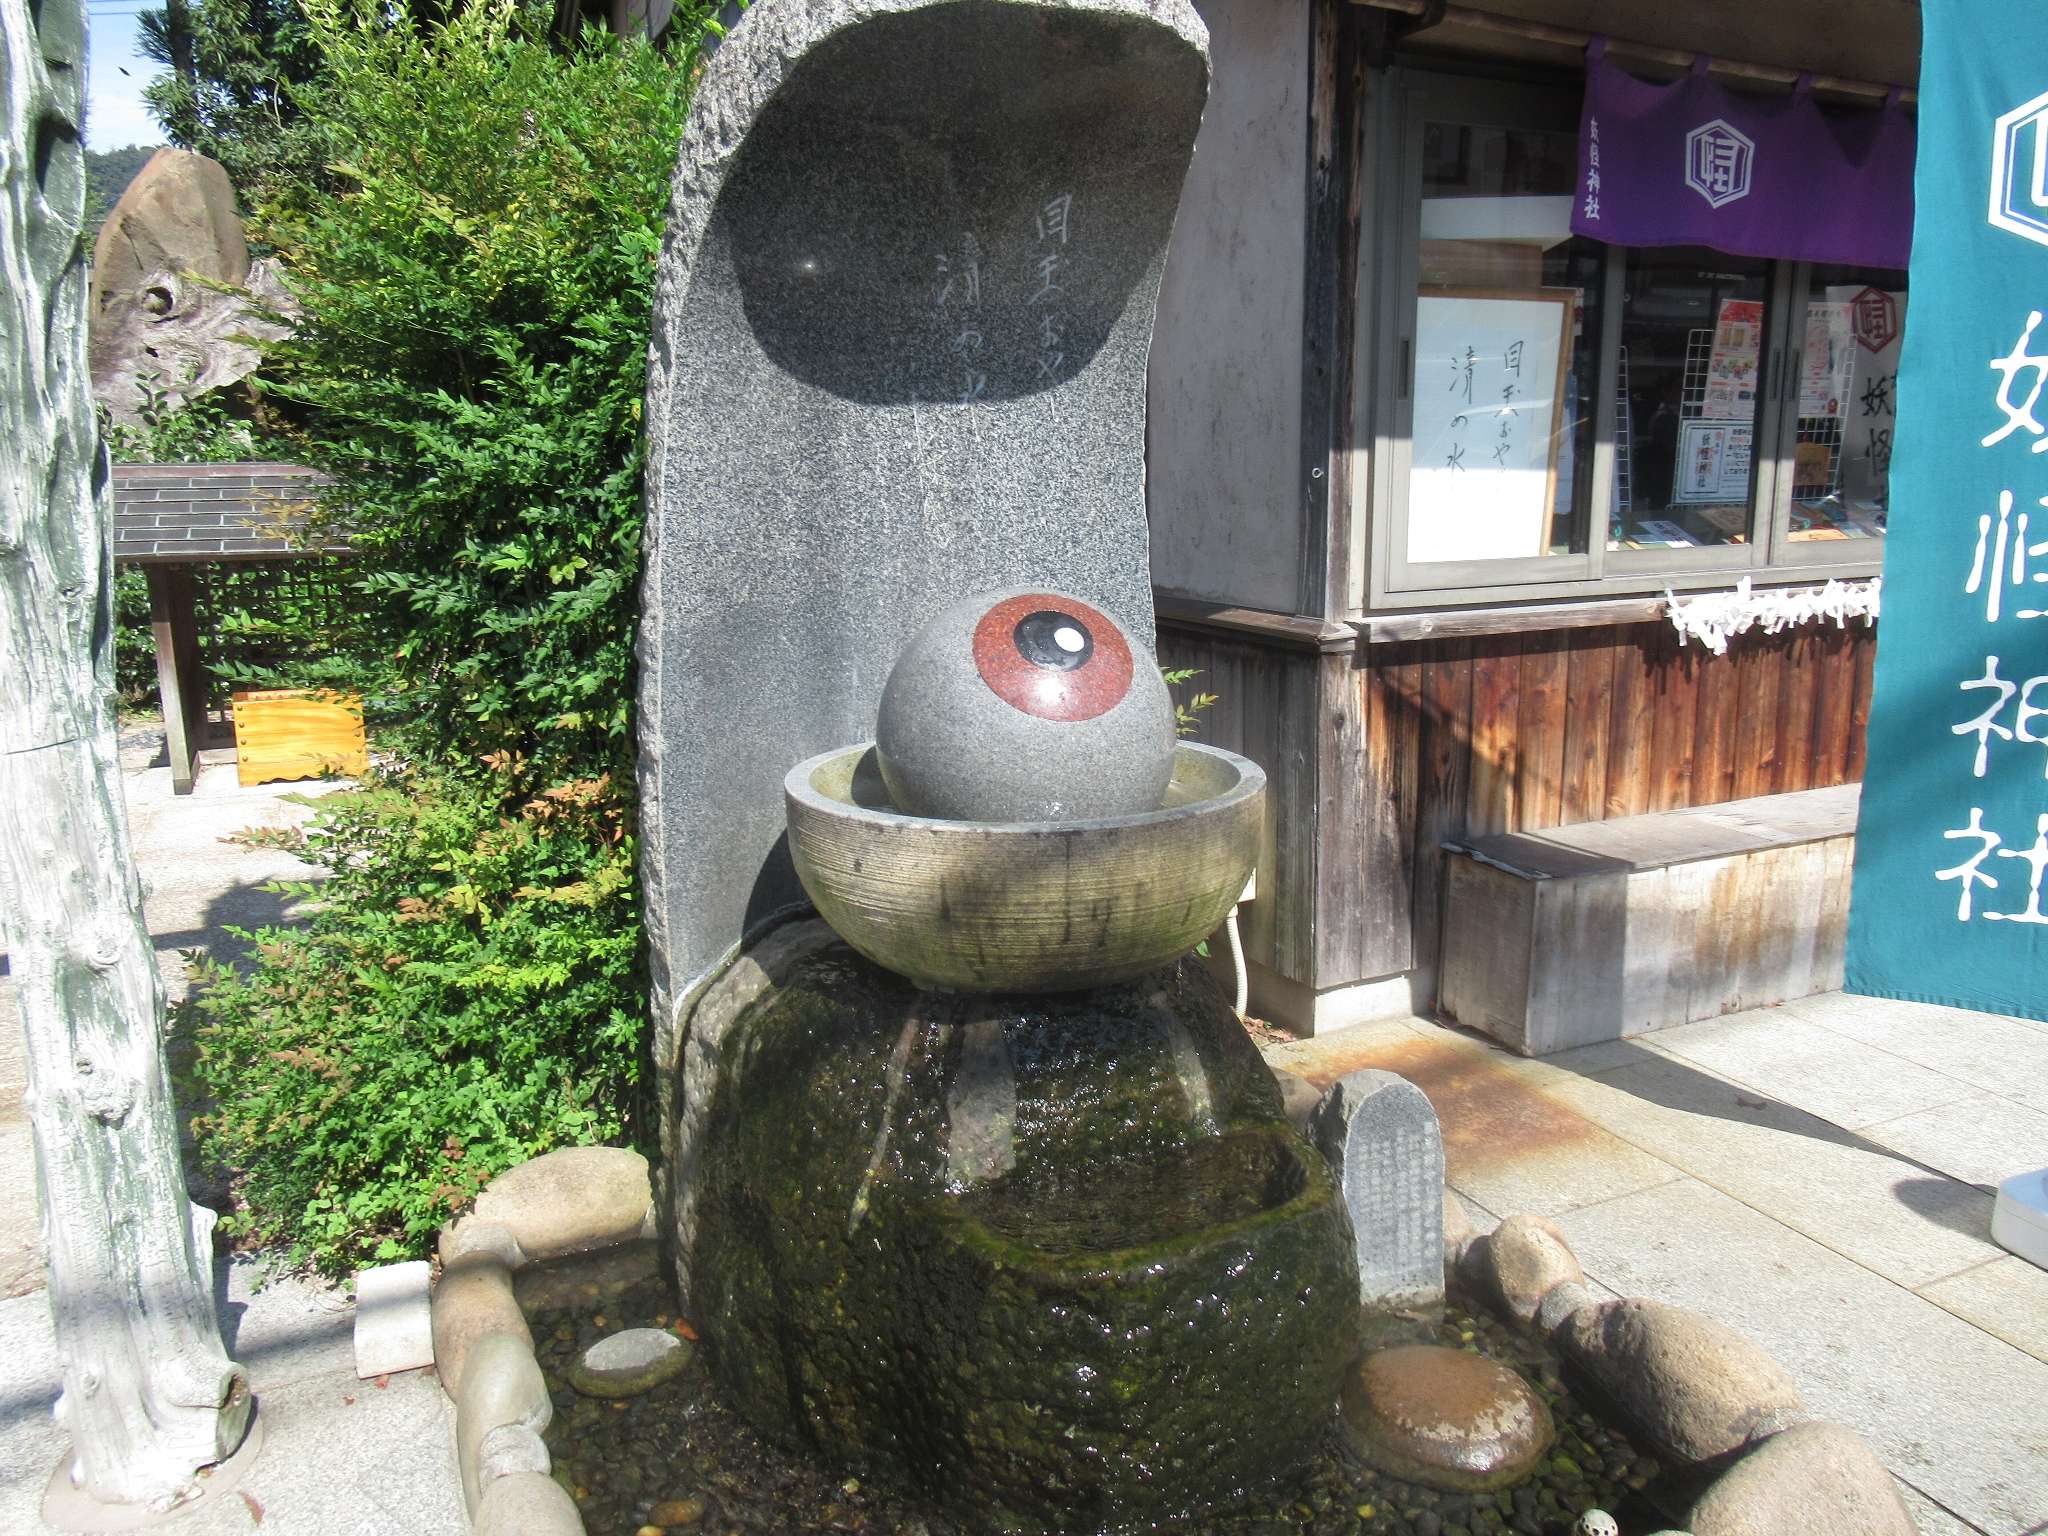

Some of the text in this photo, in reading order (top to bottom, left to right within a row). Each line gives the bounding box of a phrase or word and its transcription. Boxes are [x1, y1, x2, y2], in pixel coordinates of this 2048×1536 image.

[1493, 340, 1524, 474] 目玉おや
[1860, 376, 1892, 508] 妖怪
